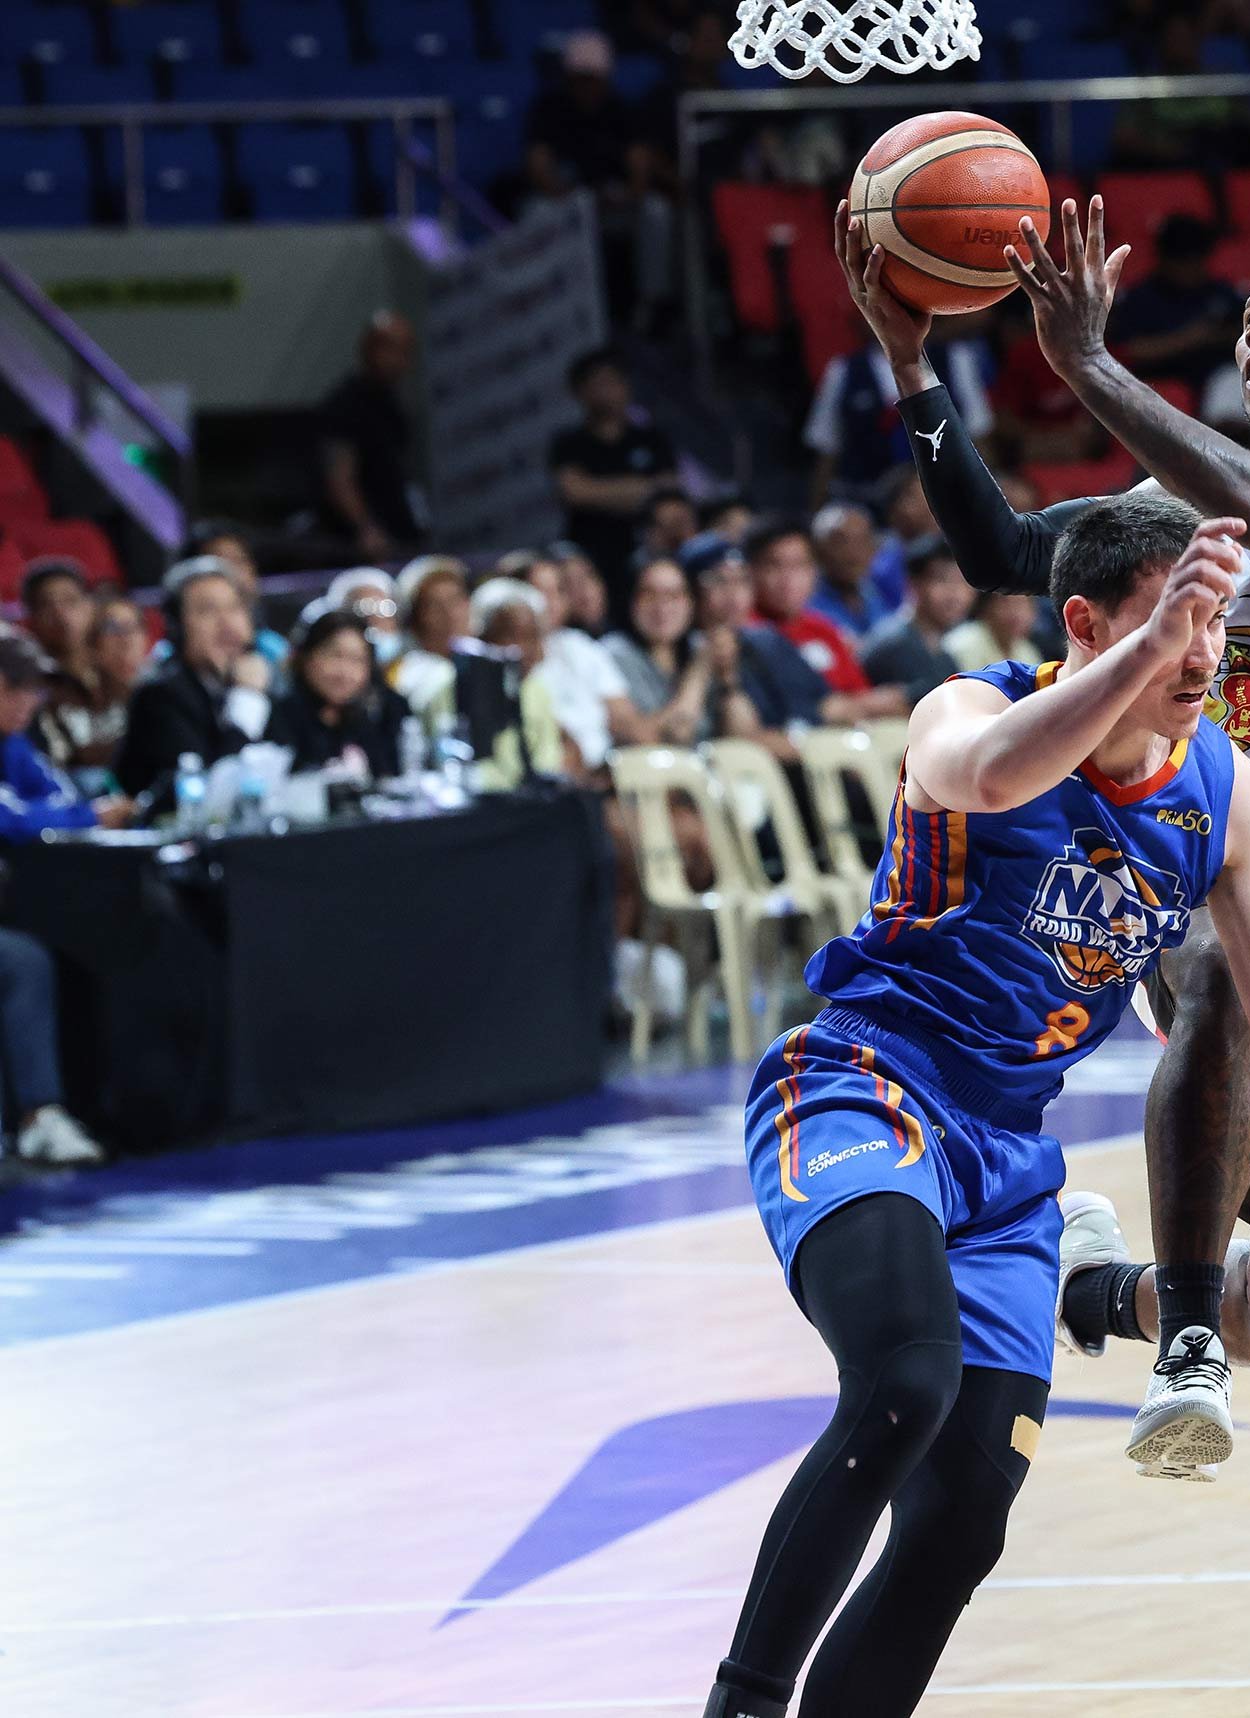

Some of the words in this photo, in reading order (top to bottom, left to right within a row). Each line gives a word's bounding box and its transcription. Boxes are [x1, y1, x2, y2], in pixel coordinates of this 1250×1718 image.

[964, 226, 1028, 247] olten
[1030, 914, 1082, 943] ROAD
[807, 1150, 832, 1168] NLEX
[808, 1140, 889, 1177] CONNECTOR
